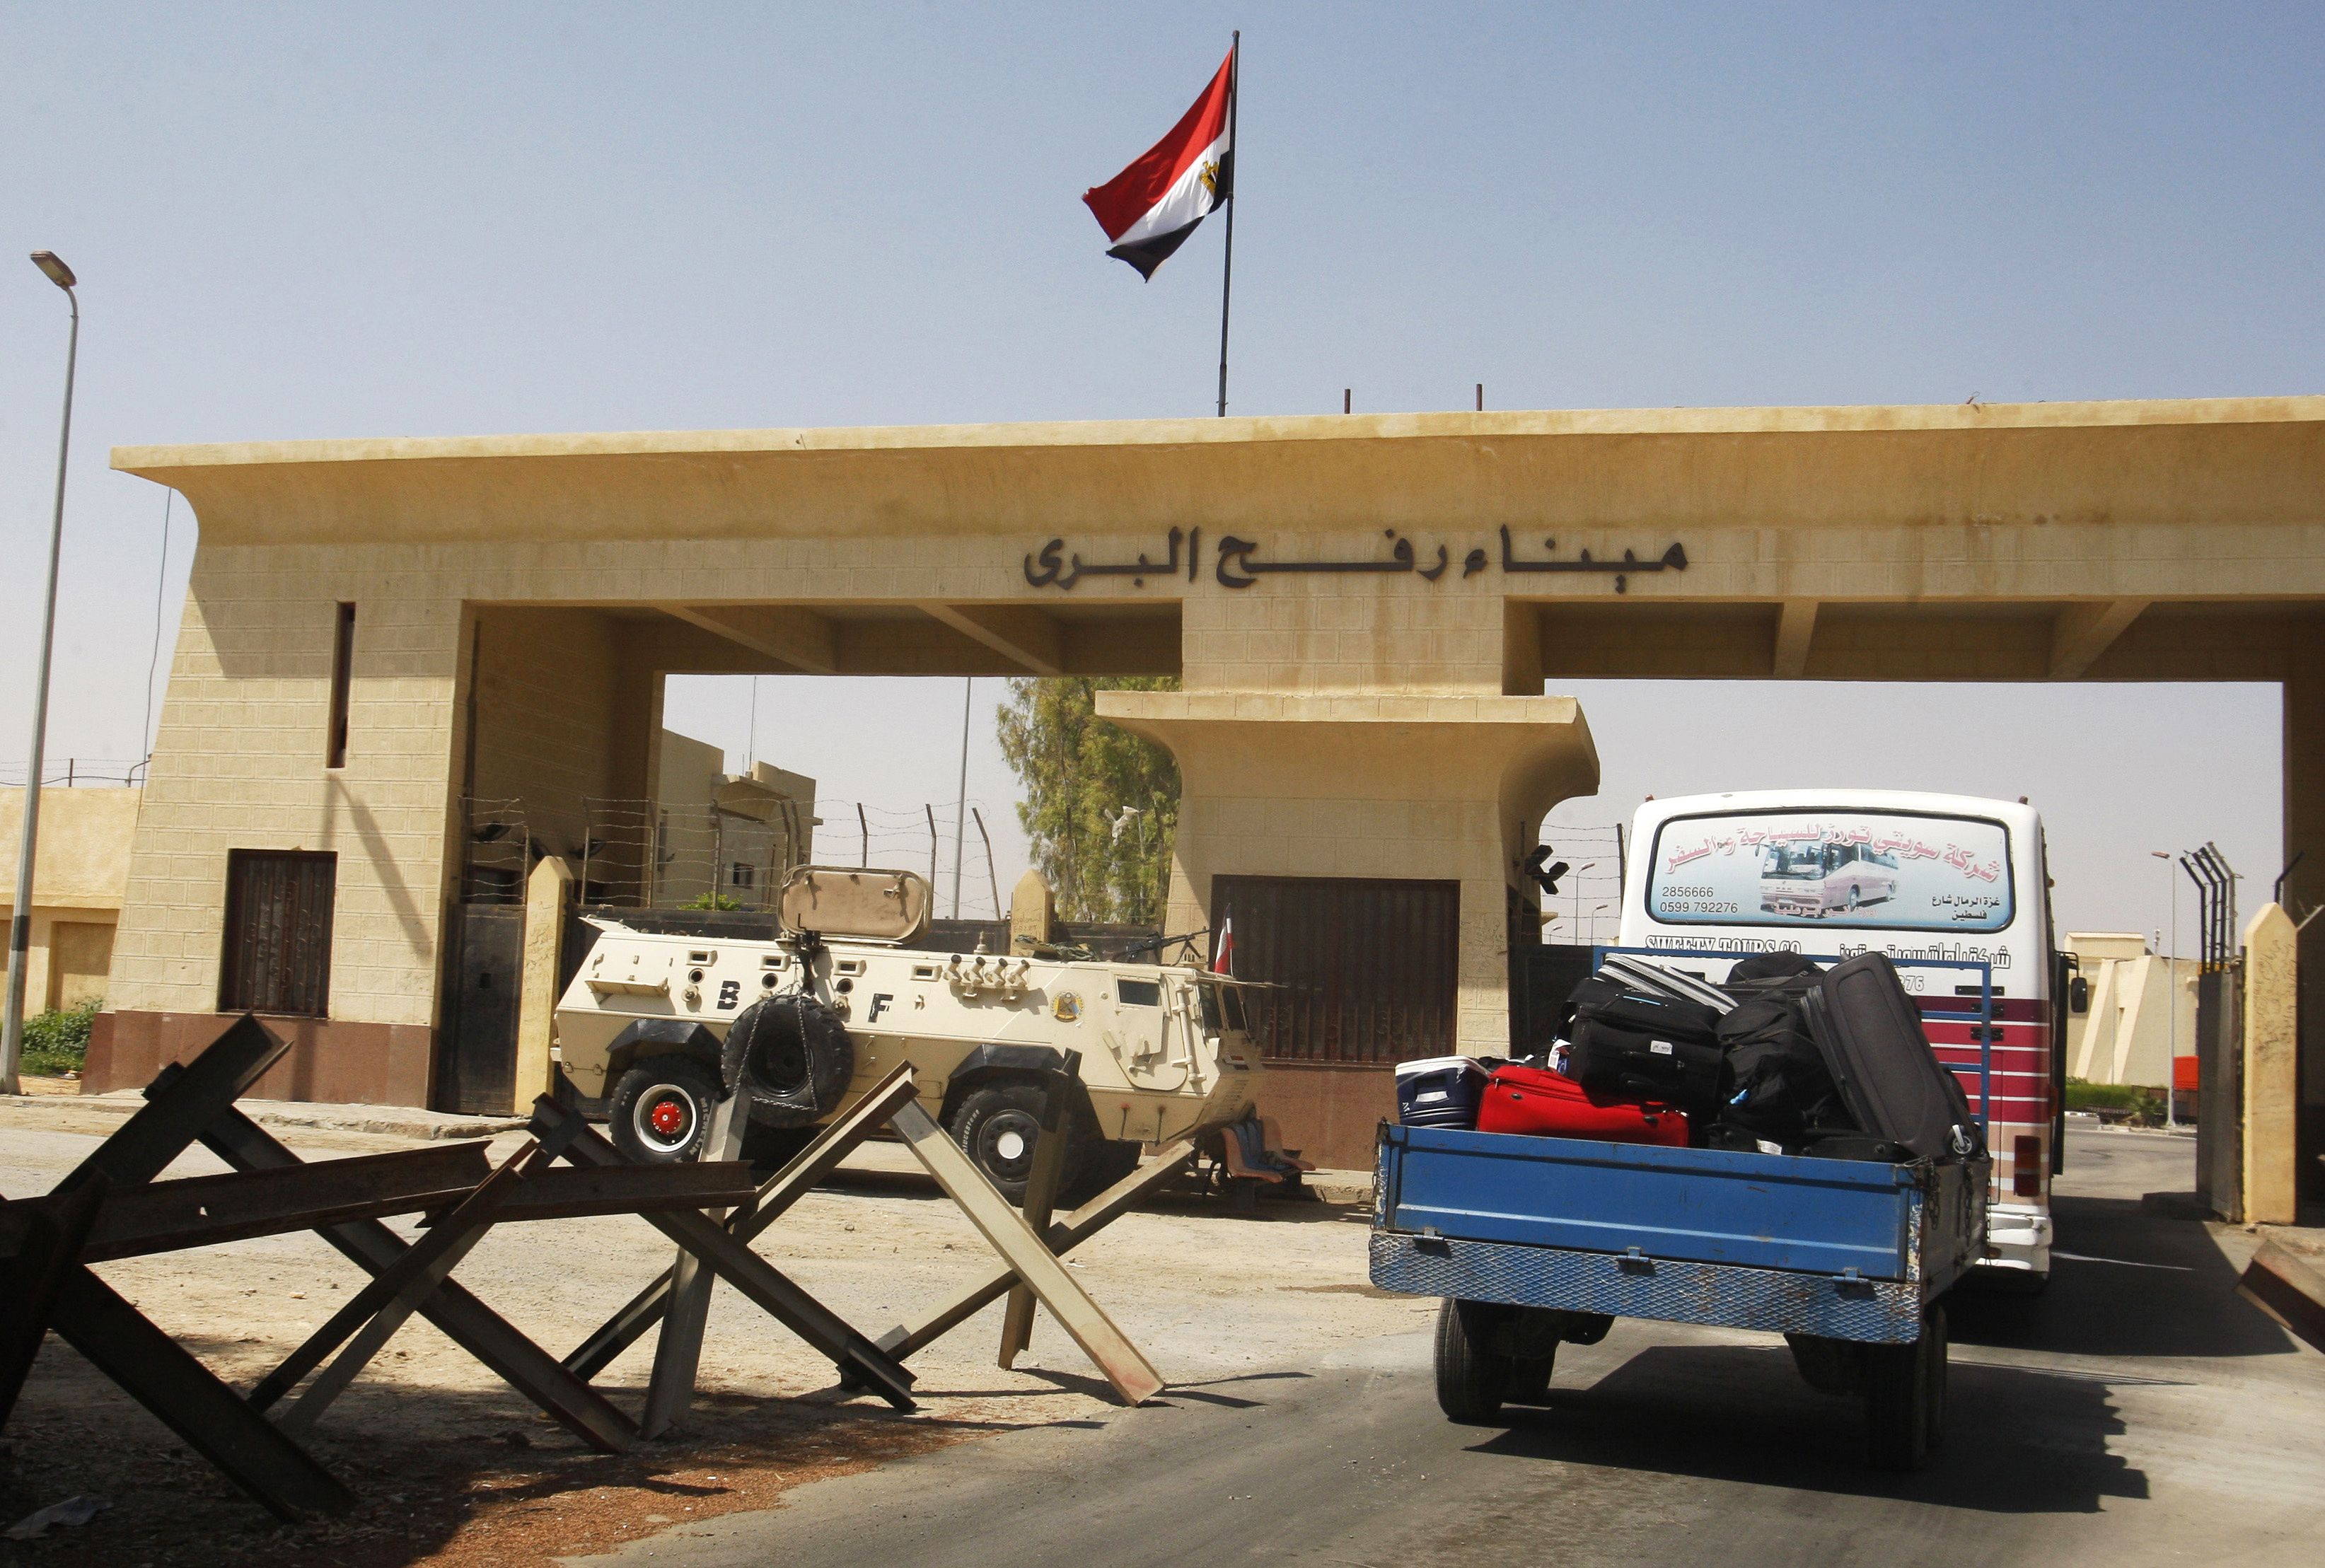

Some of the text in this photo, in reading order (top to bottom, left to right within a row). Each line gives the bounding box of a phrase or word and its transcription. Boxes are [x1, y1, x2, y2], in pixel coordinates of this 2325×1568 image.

[1216, 528, 1448, 588] رفح
[1462, 523, 1688, 594] ميناء
[1736, 823, 1823, 848] للسياحة
[1822, 823, 1872, 847] تورز
[1872, 830, 1940, 859] سويتي
[1943, 842, 2001, 883] شركة
[1662, 886, 1714, 898] 2856666
[1932, 894, 2000, 908] غزة الرمال شارع
[1659, 902, 1739, 913] 0599 792276
[1952, 910, 1988, 922] فلسطين
[717, 980, 894, 1023] B F
